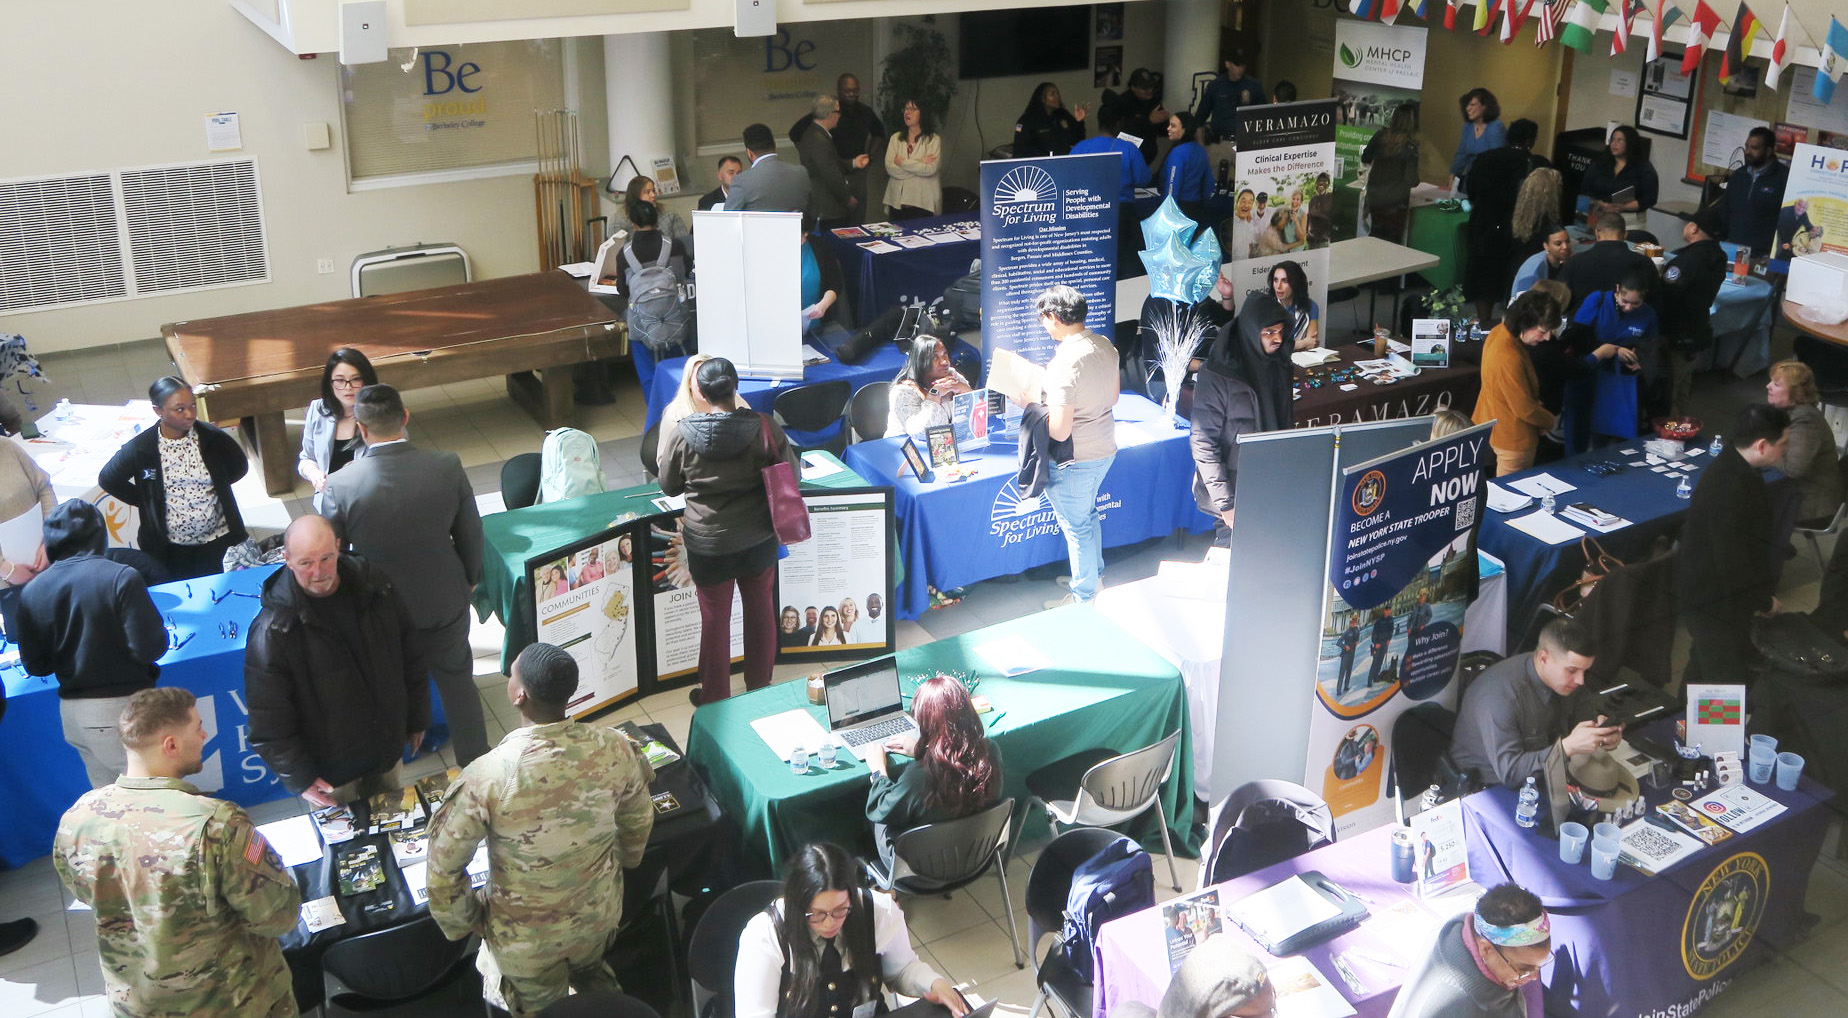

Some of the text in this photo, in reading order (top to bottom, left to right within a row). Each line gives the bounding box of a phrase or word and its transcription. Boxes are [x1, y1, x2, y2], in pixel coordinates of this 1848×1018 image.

[1367, 45, 1411, 62] MHCP
[418, 51, 483, 95] Be
[1244, 113, 1330, 132] VERAMAZO
[1255, 149, 1318, 164] Clinical Expertise
[1568, 153, 1592, 164] THANK
[1247, 160, 1324, 176] Makes the Difference
[1571, 162, 1585, 171] YOU
[1065, 188, 1089, 197] Serving
[1065, 196, 1086, 205] People
[992, 202, 1055, 218] Spectrum
[1065, 202, 1111, 213] Developmental
[1065, 211, 1099, 220] Disabilities
[1002, 212, 1057, 228] for Living
[1412, 437, 1484, 485] APPLY
[1430, 470, 1479, 507] NOW
[1348, 506, 1450, 549] NEW YORK STATE TROOPER
[1350, 510, 1391, 533] BECOME A
[1000, 522, 1061, 548] for Living
[1346, 535, 1408, 563] joinstatepolice.ny.gov
[1344, 553, 1385, 575] #JoinNYSP
[541, 586, 600, 615] COMMUNITIES
[670, 591, 692, 603] JOIN
[1415, 628, 1449, 646] Why Join?
[1716, 807, 1746, 824] FOLLOW
[1736, 858, 1762, 879] YORK
